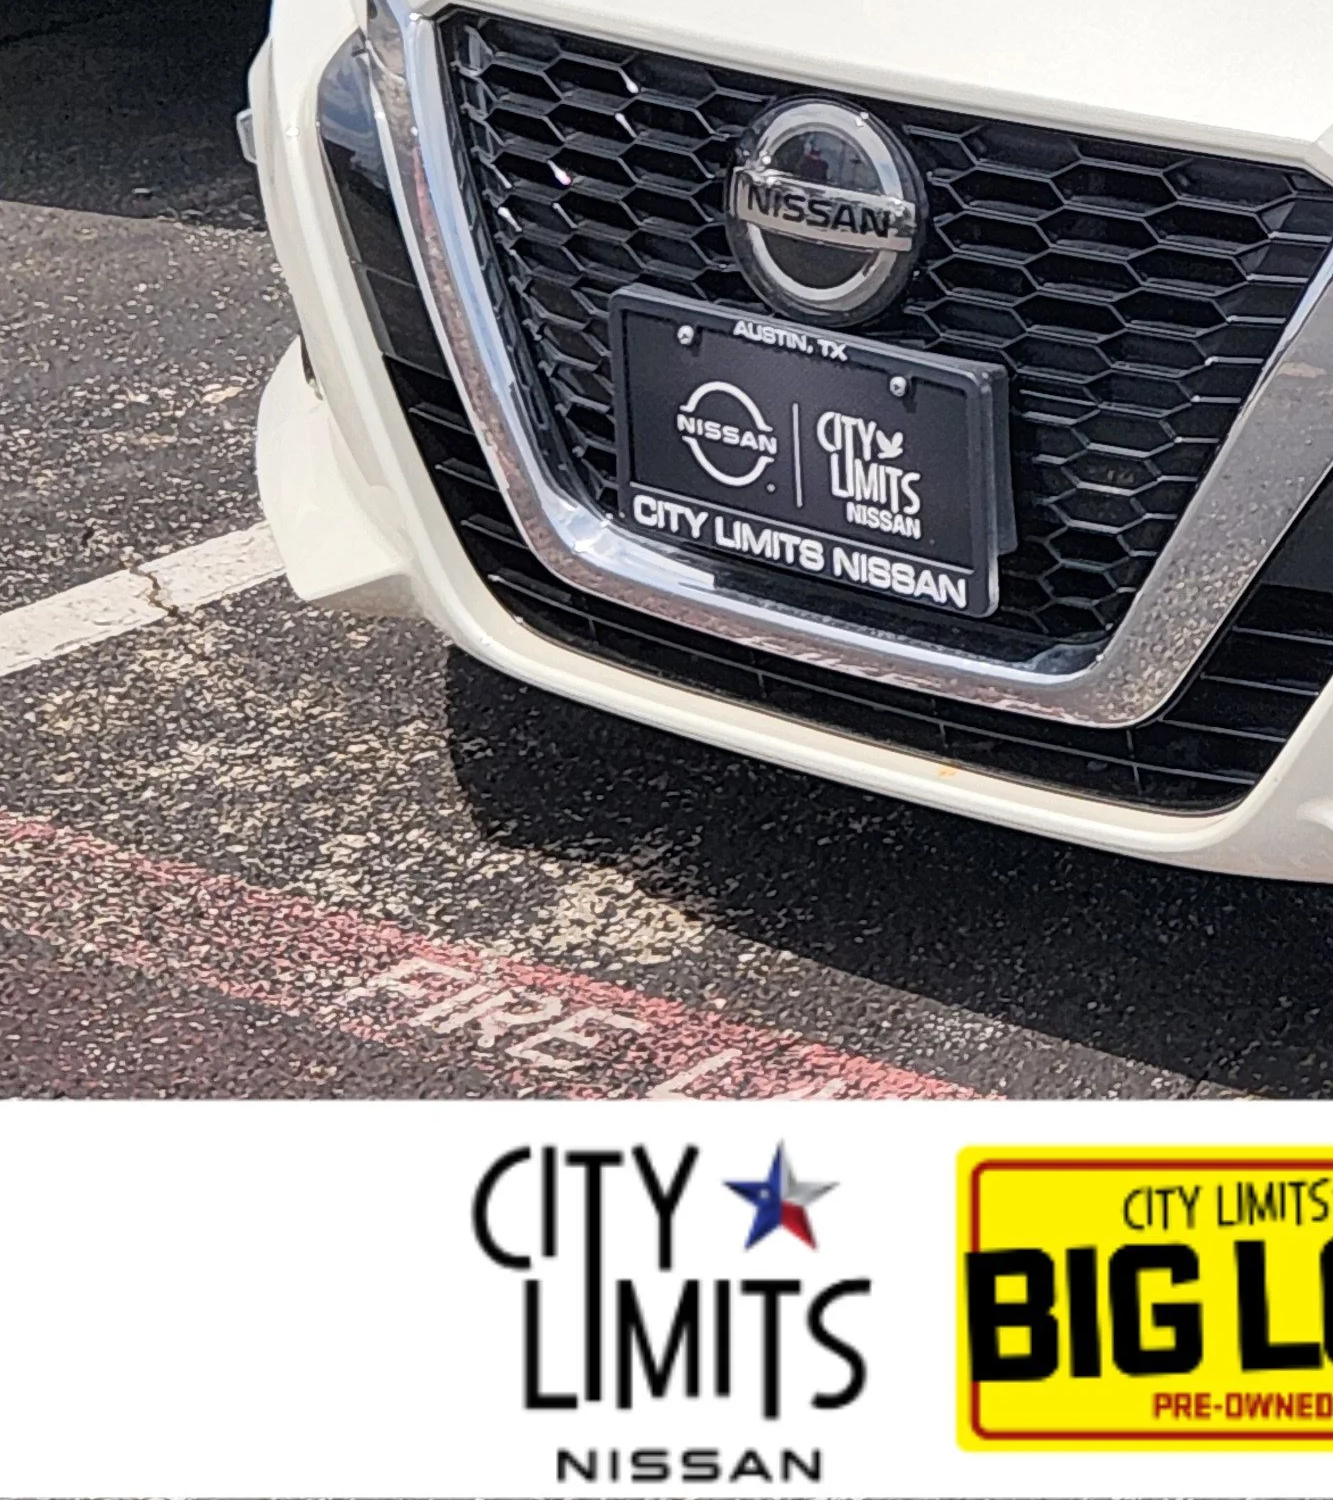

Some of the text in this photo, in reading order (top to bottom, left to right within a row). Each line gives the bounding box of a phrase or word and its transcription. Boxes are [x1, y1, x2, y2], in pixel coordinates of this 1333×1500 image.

[747, 181, 891, 239] NISSAN
[733, 320, 848, 362] AUSTIN, TX
[677, 412, 777, 455] NISSAN
[817, 411, 877, 461] CITY
[830, 452, 921, 515] LIMITS
[846, 501, 921, 540] NISSAN
[633, 494, 967, 609] CITY LIMITS NISSAN
[342, 957, 652, 1070] FIRE
